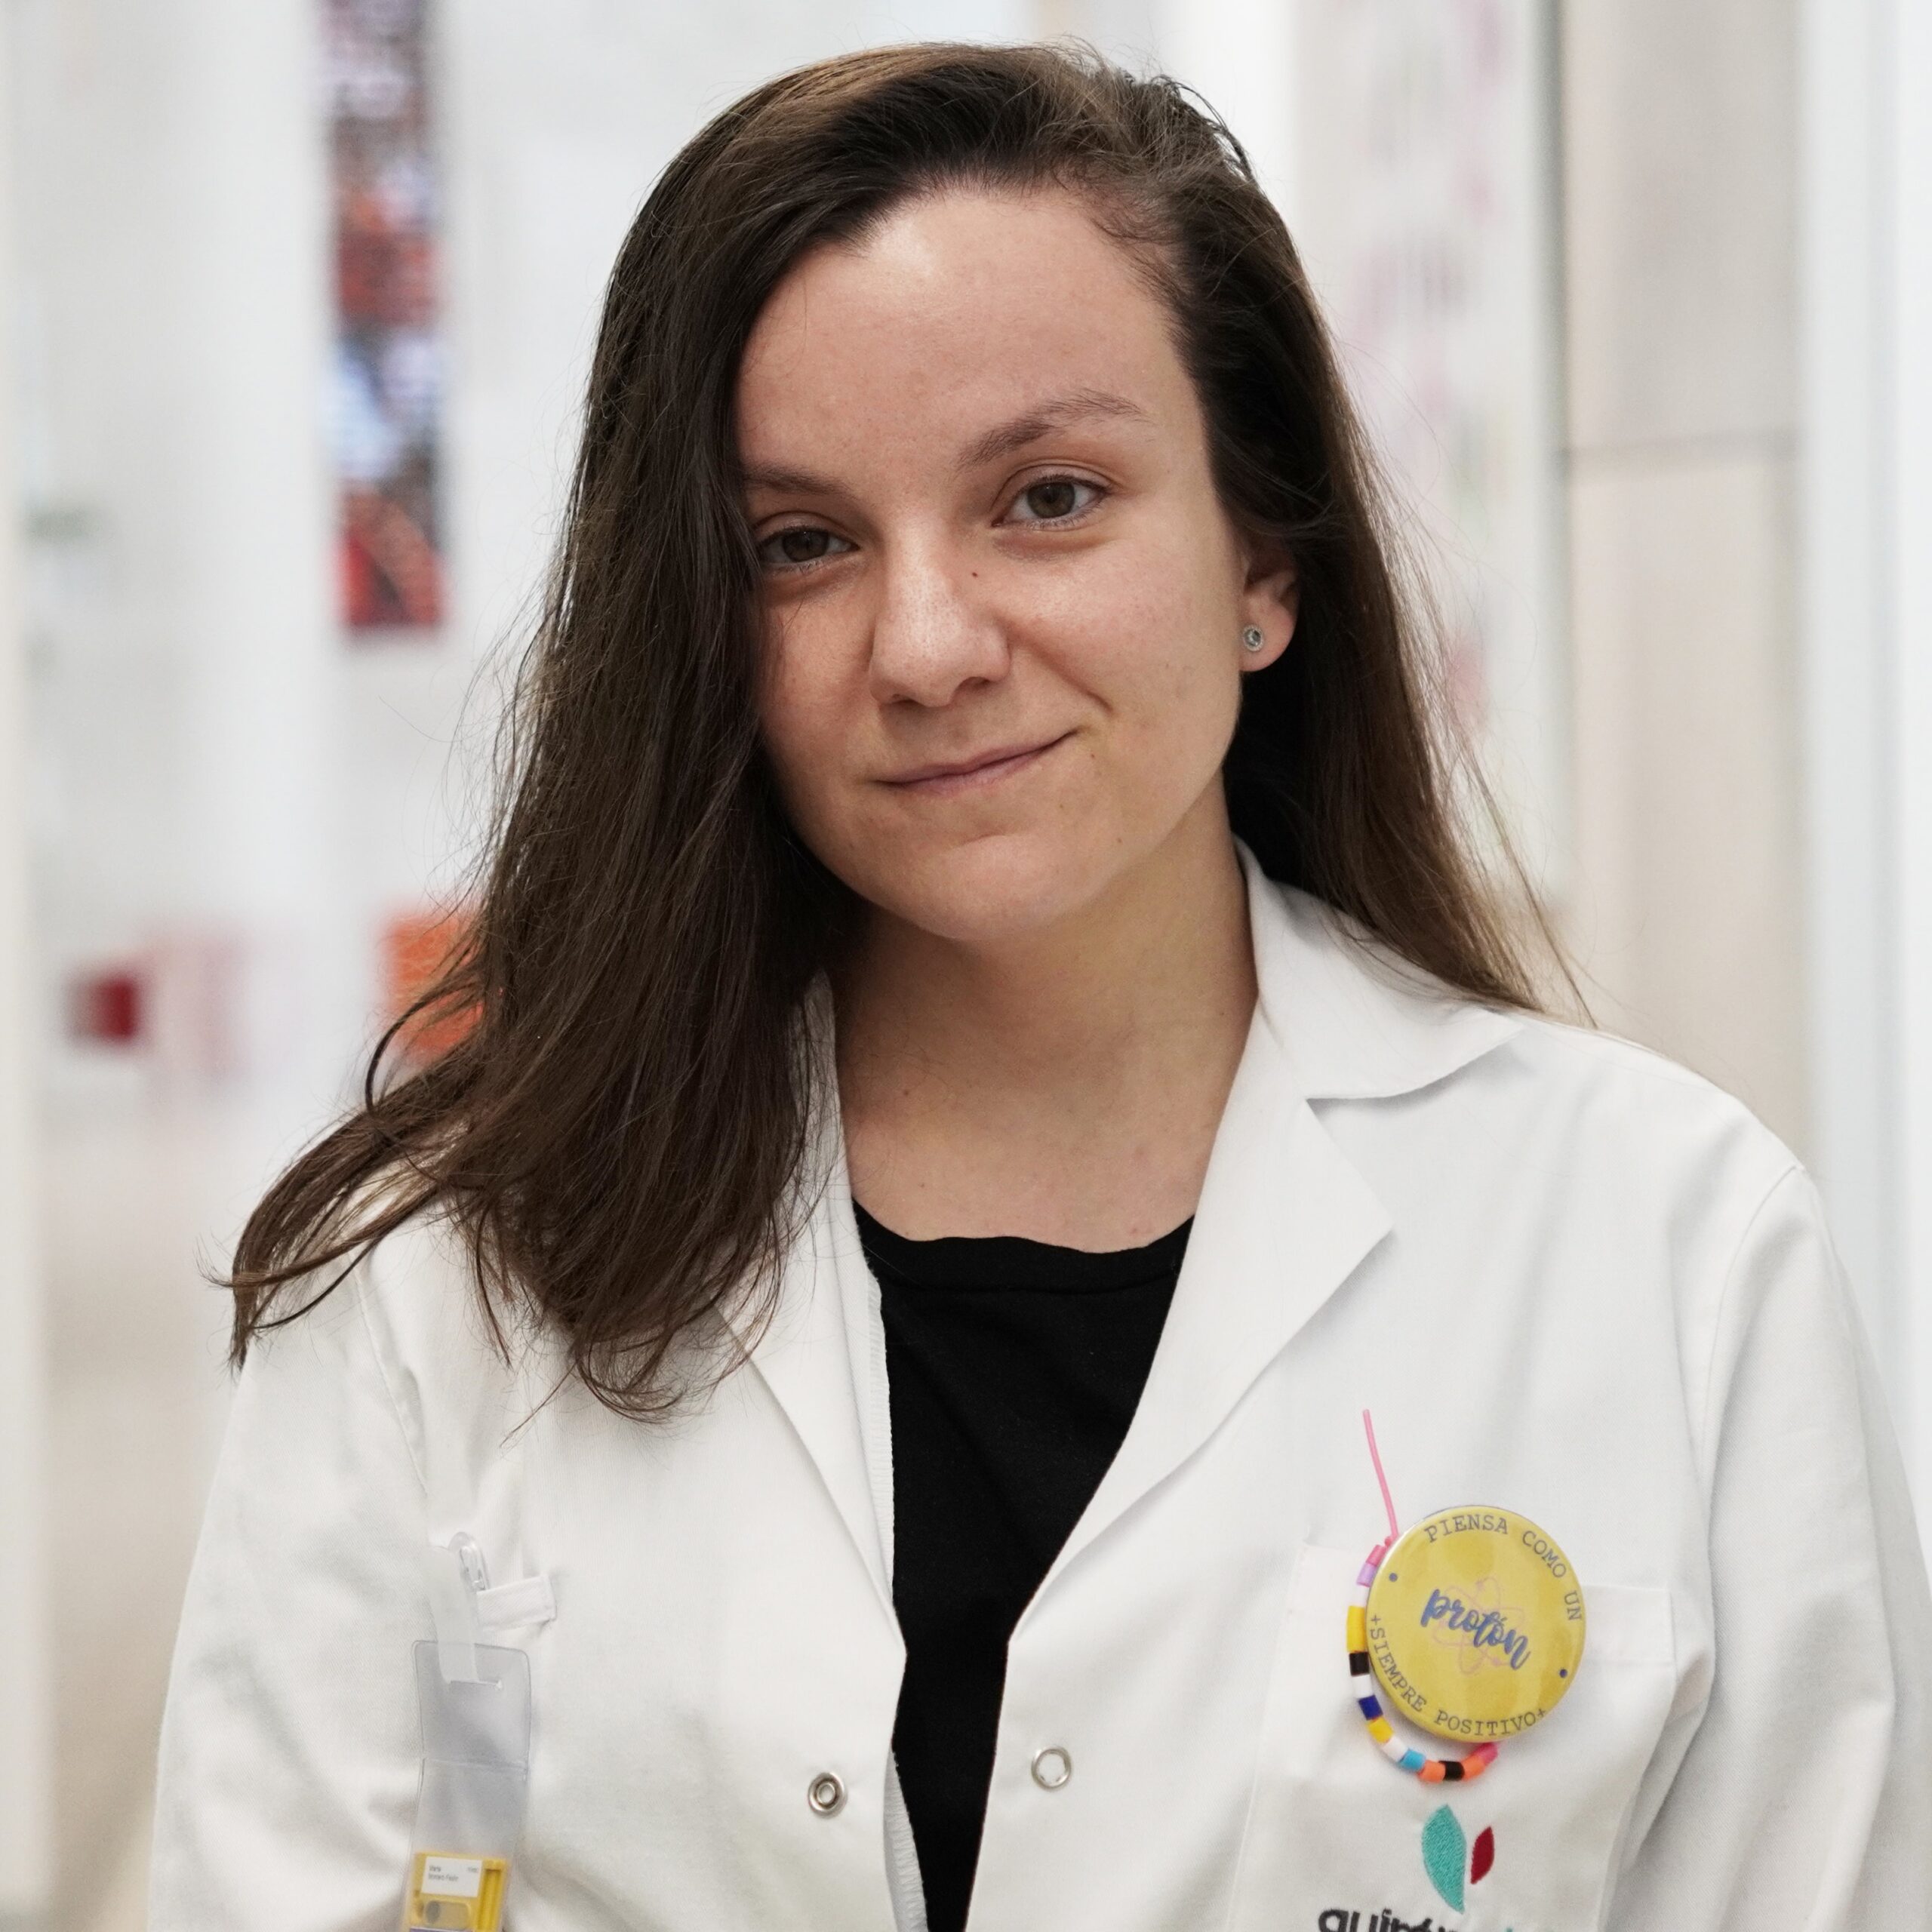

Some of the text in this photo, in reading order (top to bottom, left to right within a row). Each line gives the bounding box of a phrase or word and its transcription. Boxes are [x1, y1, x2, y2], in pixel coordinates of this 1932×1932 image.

[1424, 1514, 1583, 1621] PIENSA COMO UN
[1420, 1589, 1531, 1671] protón
